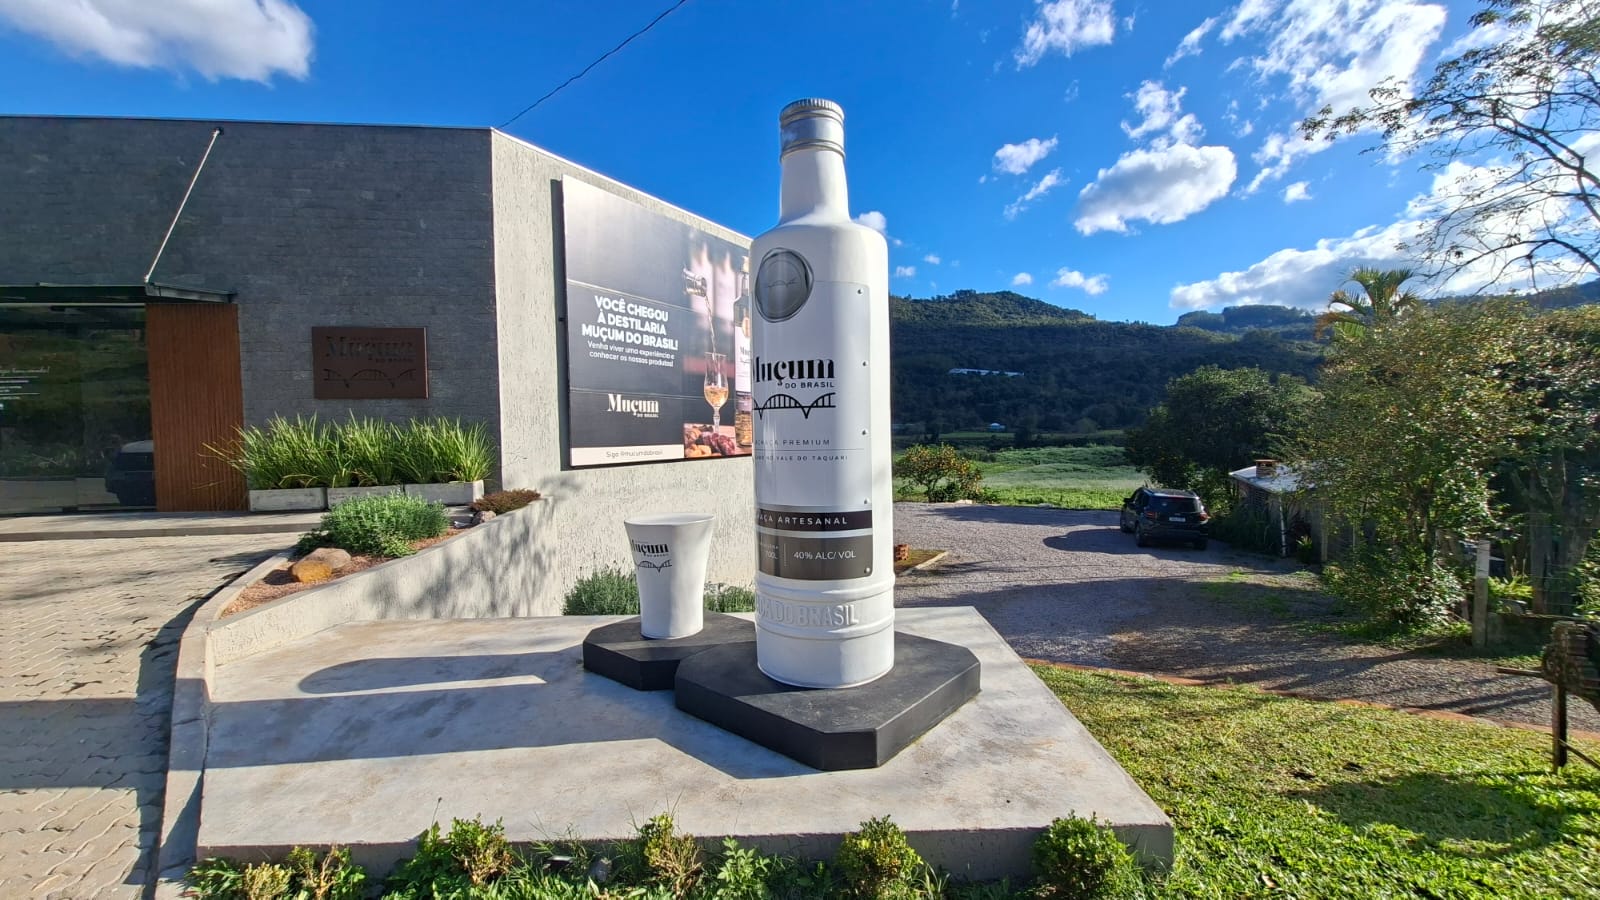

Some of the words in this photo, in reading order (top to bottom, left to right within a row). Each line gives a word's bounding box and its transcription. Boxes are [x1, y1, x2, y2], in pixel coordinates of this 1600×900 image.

[595, 295, 625, 313] VOCÊ
[627, 304, 669, 322] CHEGOU
[597, 309, 606, 324] À
[608, 313, 667, 335] DESTILARIA
[582, 323, 624, 342] MUÇUM
[626, 331, 641, 345] DO
[643, 334, 679, 351] BRASIL!
[588, 340, 608, 350] Venha
[609, 344, 624, 353] viver
[589, 351, 619, 360] conhecer
[628, 356, 648, 364] nossos
[752, 356, 835, 386] uçum
[801, 381, 835, 389] BRASIL
[607, 393, 659, 416] Muçum
[778, 516, 848, 526] ARTESANAL
[793, 551, 813, 560] 40%
[797, 604, 860, 627] BRASIL
